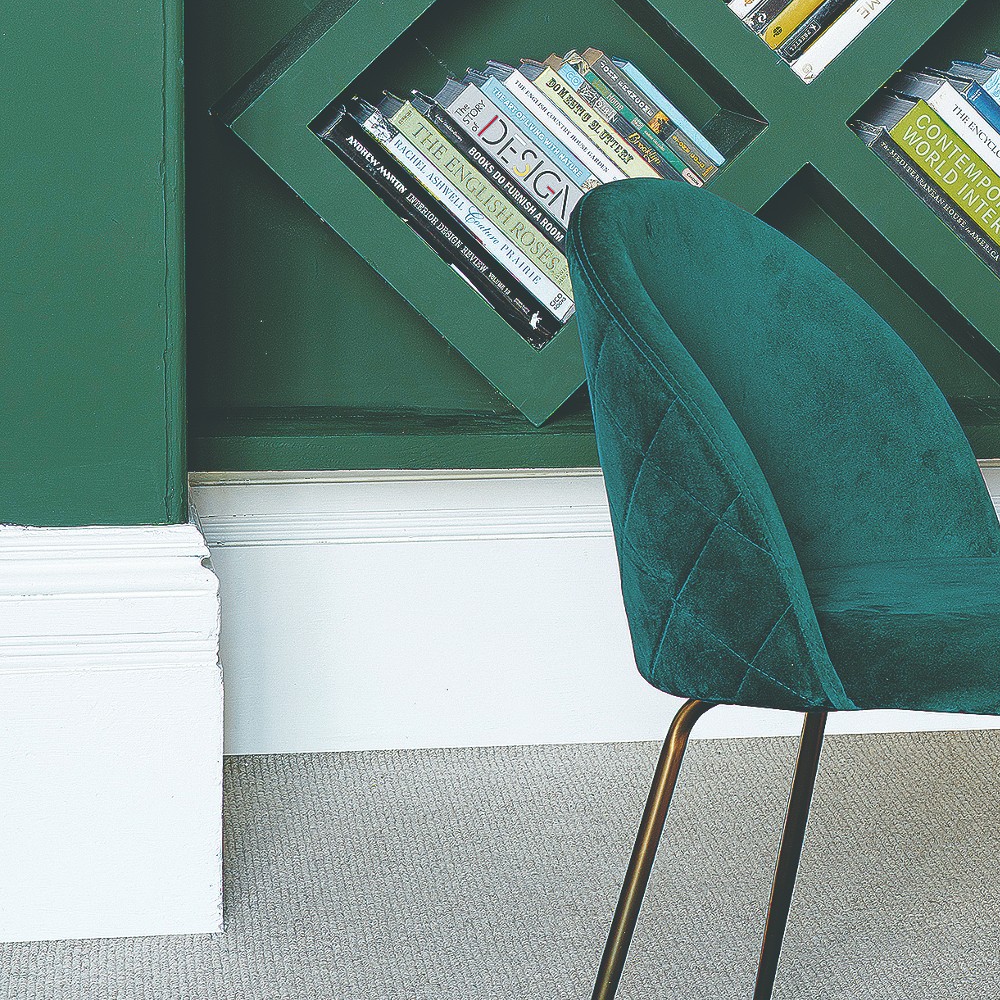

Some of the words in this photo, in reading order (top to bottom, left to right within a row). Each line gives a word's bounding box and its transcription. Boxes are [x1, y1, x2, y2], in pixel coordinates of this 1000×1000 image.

[453, 102, 471, 117] The
[461, 99, 487, 125] STORY
[470, 122, 480, 133] of
[492, 86, 506, 102] THE
[503, 98, 518, 113] ART
[515, 109, 527, 122] OF
[524, 119, 545, 141] LIVING
[542, 137, 560, 155] WITH
[557, 153, 583, 177] NATURE
[393, 138, 428, 174] RACHEL
[425, 171, 466, 211] ASHWELL
[477, 114, 583, 220] DESIGN
[901, 125, 959, 186] WORLD
[410, 121, 448, 160] THE
[443, 154, 514, 226] ENGLISH
[509, 220, 560, 271] ROSES
[462, 203, 505, 247] Couture
[499, 243, 542, 285] PRAIRIE
